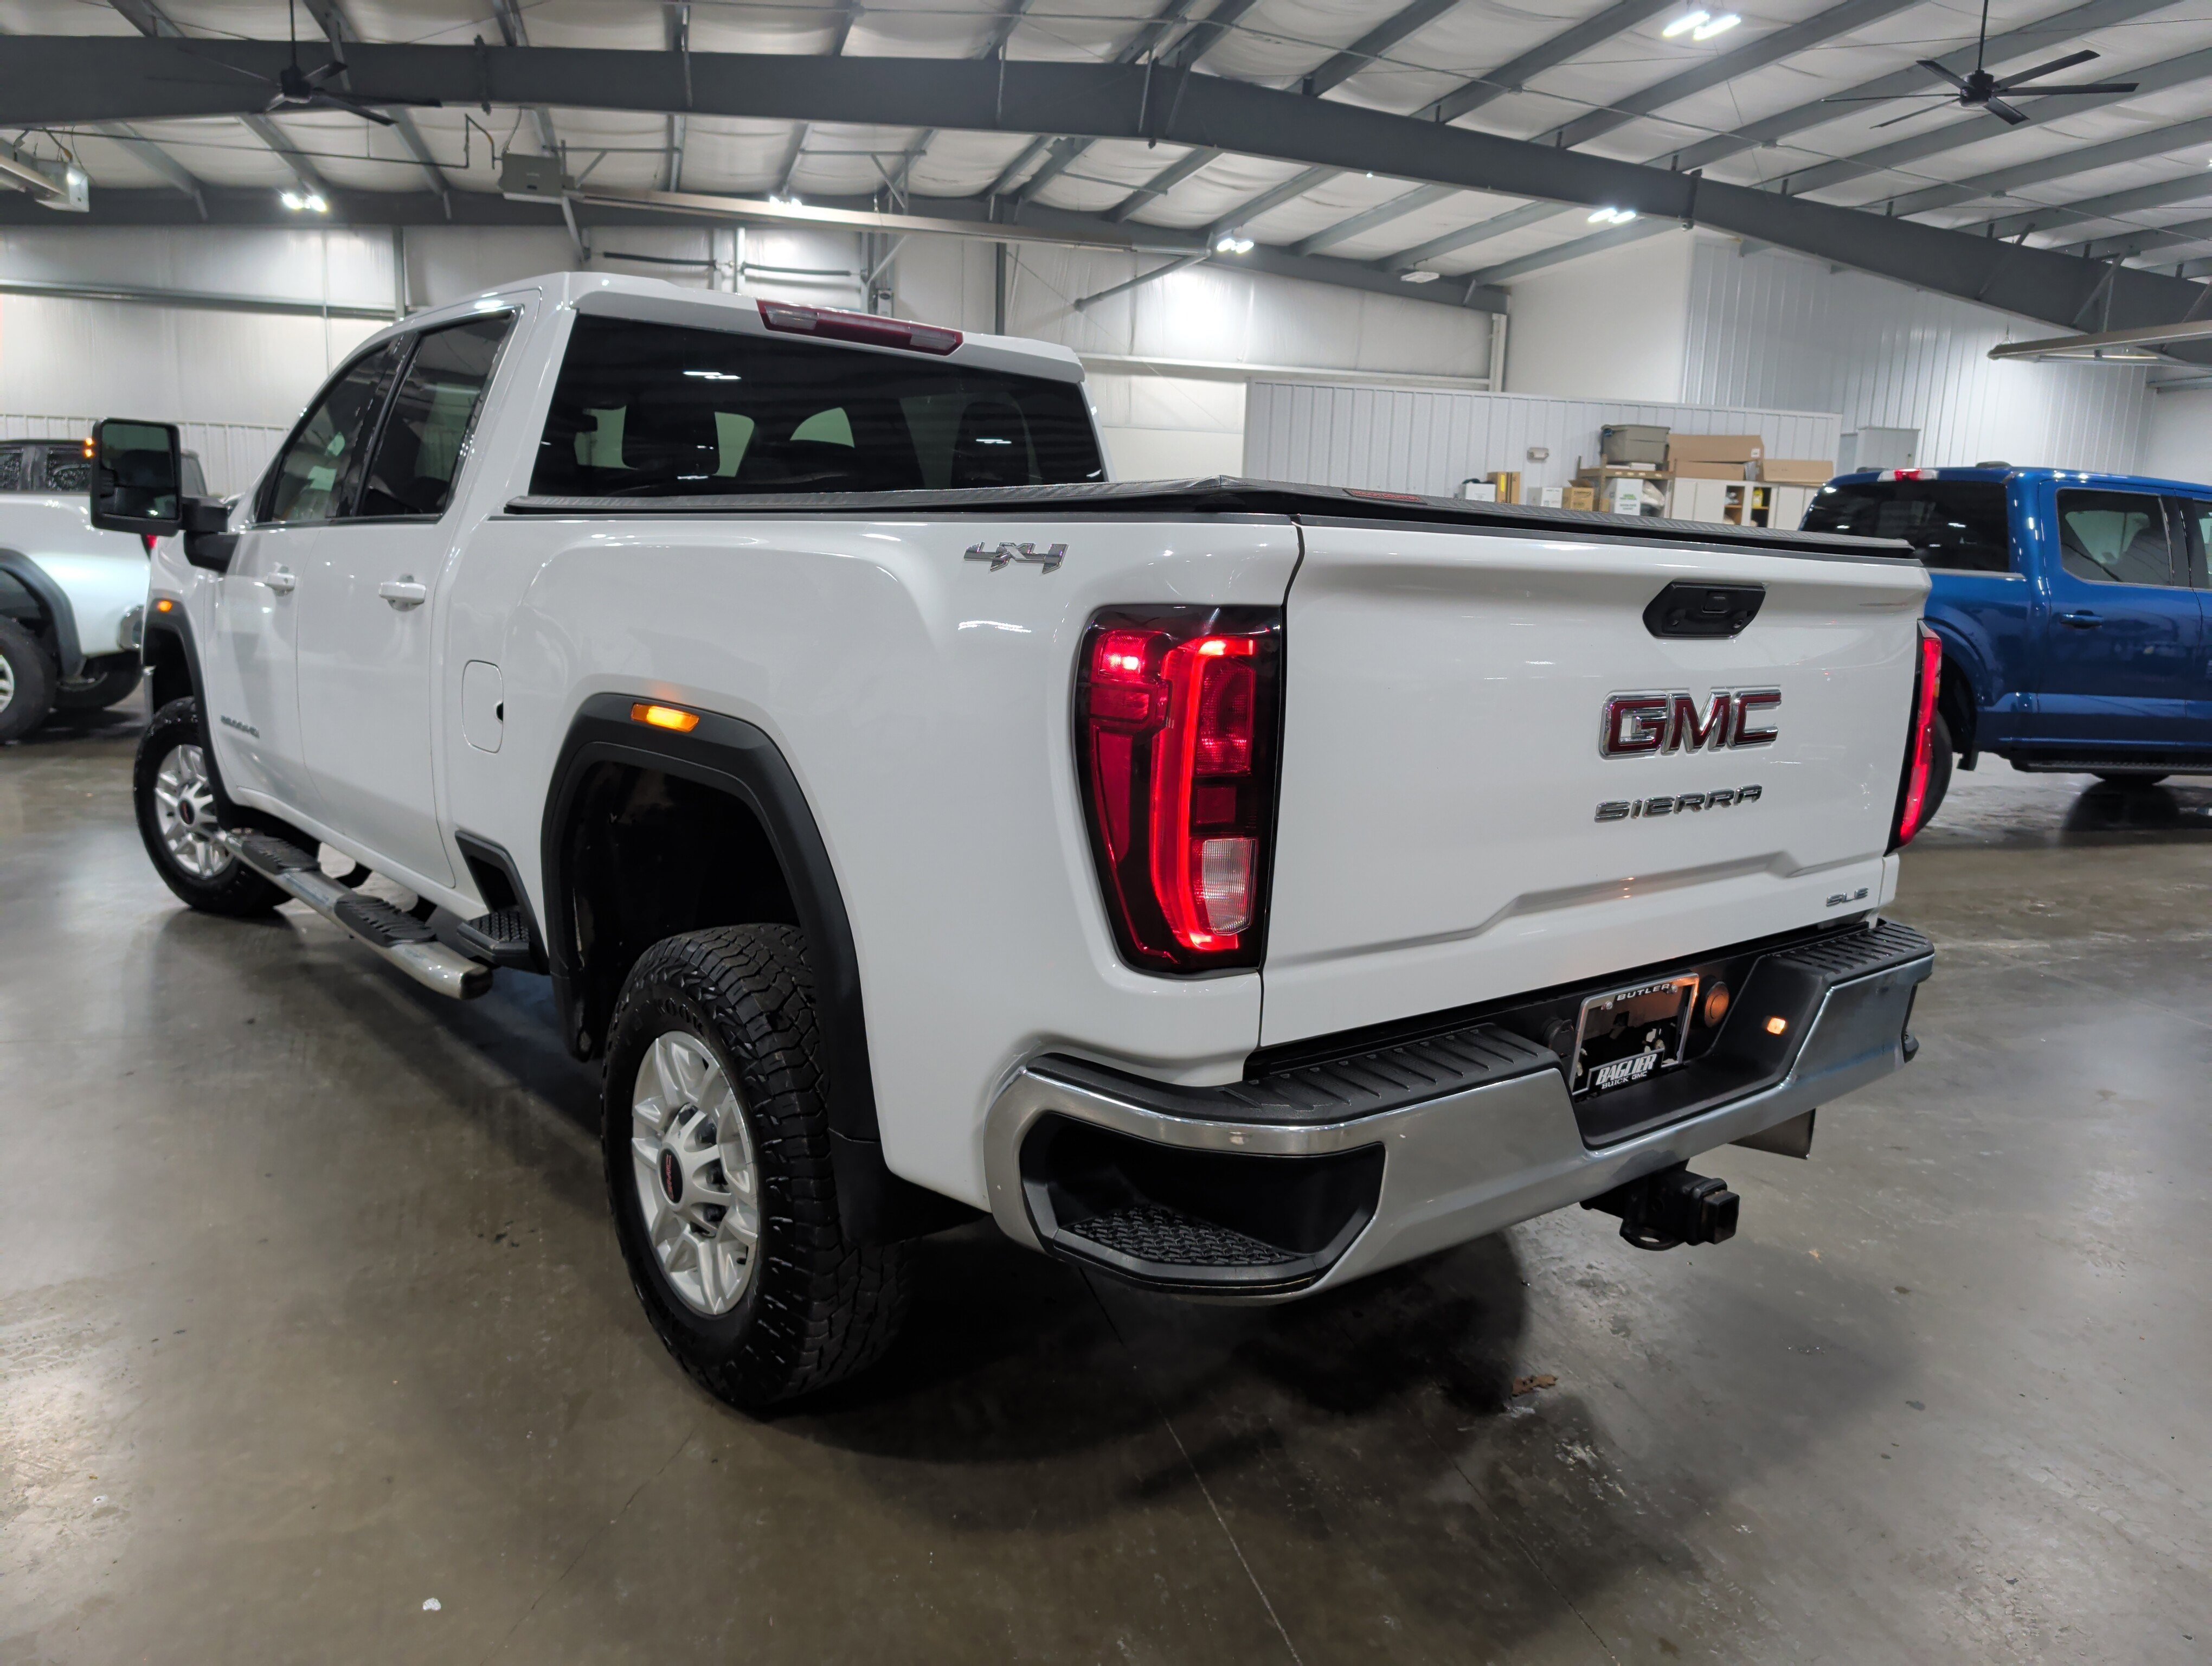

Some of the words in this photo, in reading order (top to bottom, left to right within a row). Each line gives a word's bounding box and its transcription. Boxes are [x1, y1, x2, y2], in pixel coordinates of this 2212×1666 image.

[1598, 689, 1782, 760] GMC
[1594, 784, 1763, 823] SIERRA
[1825, 883, 1869, 907] SLE
[1617, 983, 1670, 1001] BUTLER
[1596, 1054, 1657, 1085] BAGLIER
[1601, 1076, 1630, 1090] BUICK
[1631, 1071, 1648, 1080] GMC
